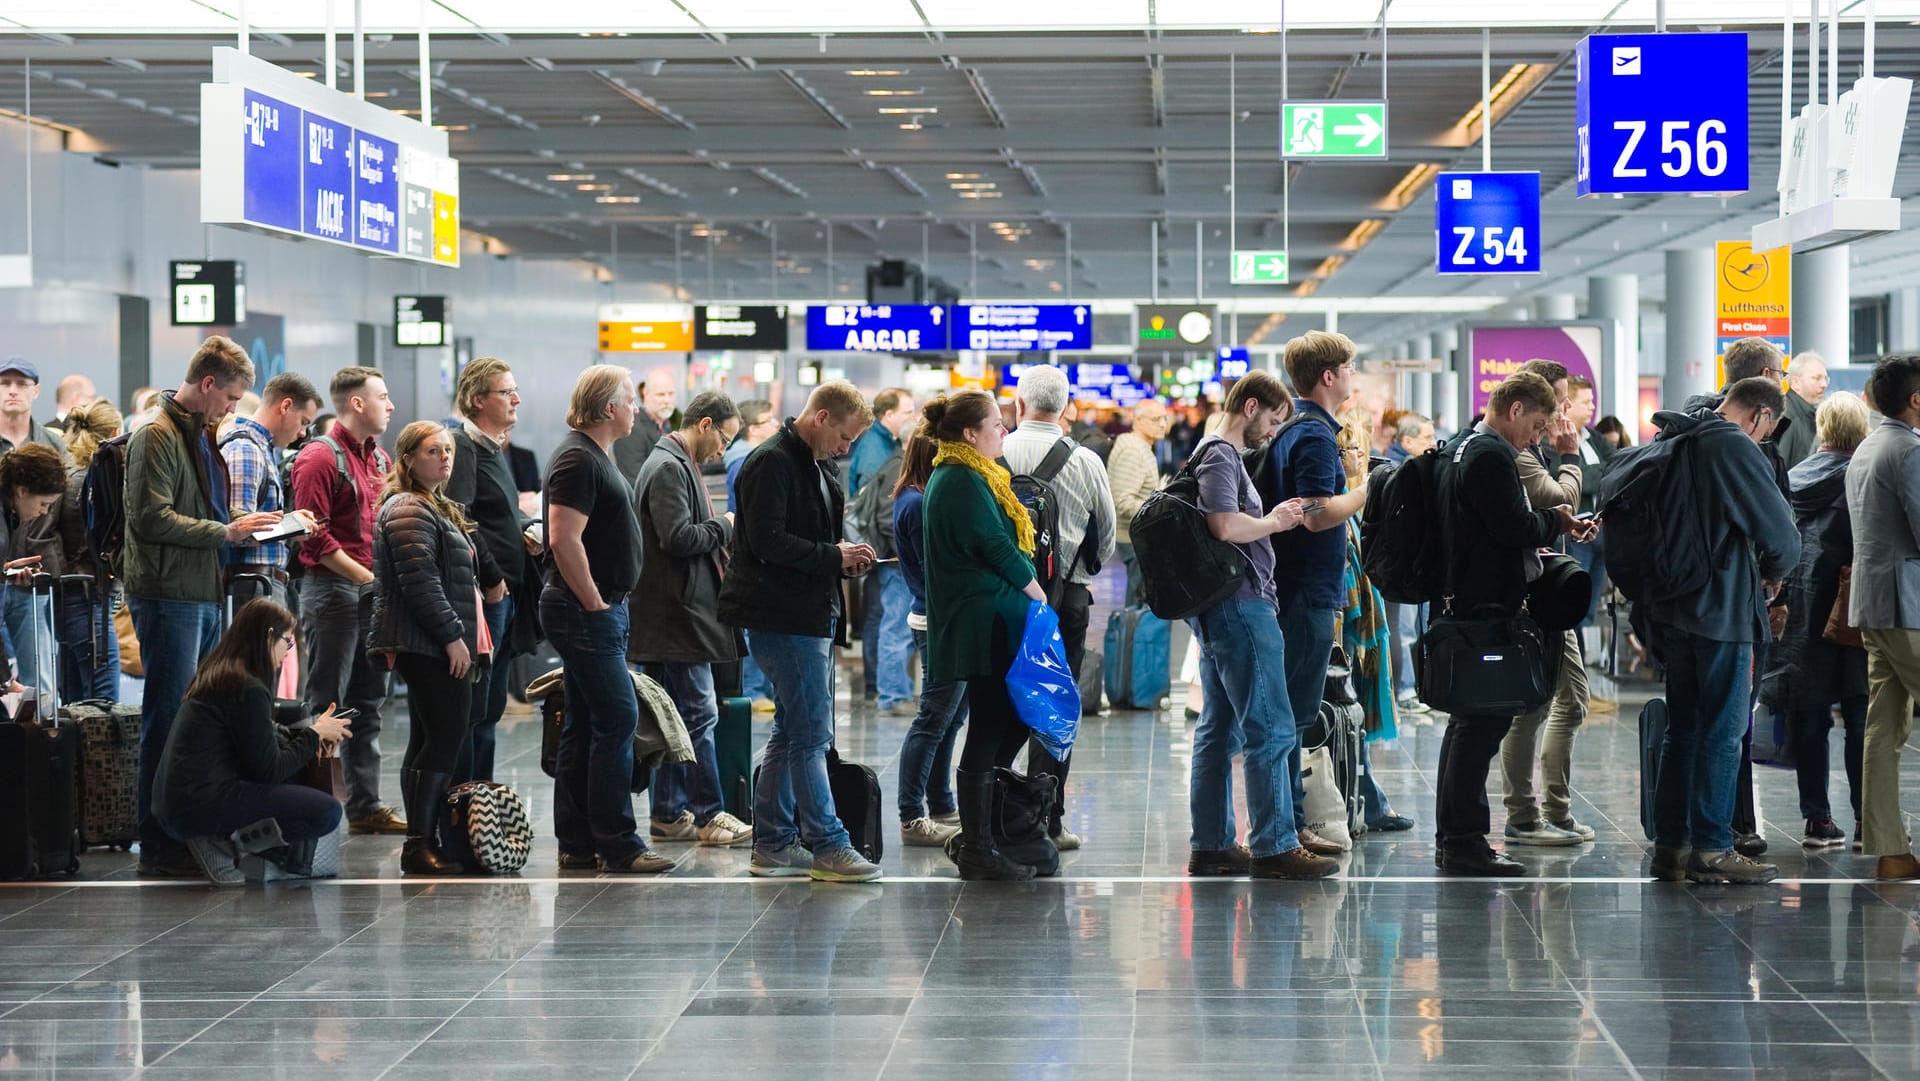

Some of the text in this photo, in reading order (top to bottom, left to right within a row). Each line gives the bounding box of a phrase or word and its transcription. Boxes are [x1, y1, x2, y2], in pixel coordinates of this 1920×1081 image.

[1613, 119, 1728, 177] Z 56
[1452, 226, 1528, 265] Z 54
[845, 305, 859, 325] Z
[1722, 302, 1785, 313] Lufthansa
[1722, 322, 1768, 332] First Class
